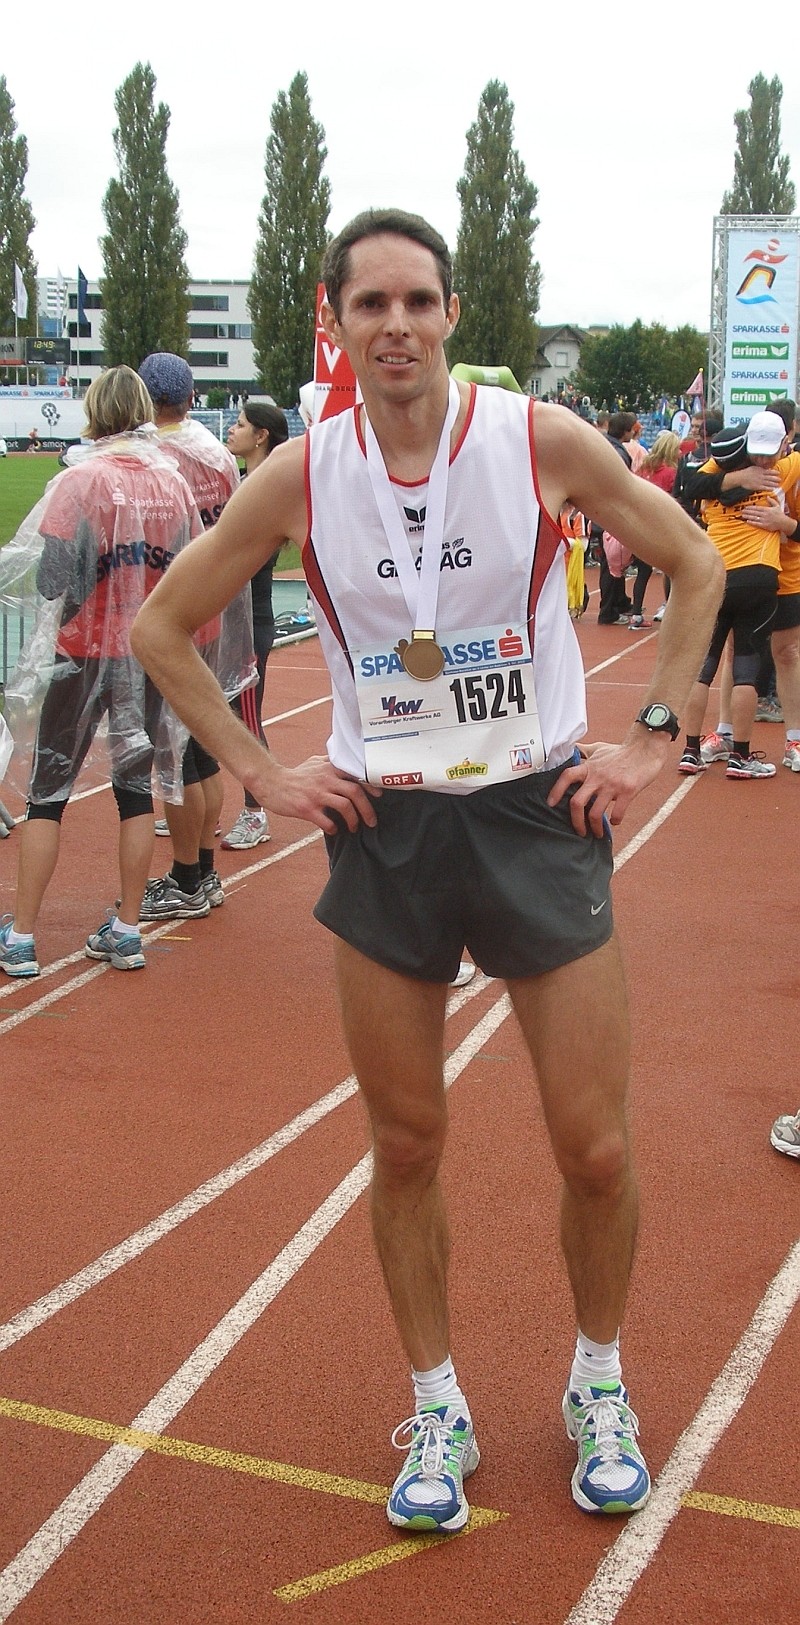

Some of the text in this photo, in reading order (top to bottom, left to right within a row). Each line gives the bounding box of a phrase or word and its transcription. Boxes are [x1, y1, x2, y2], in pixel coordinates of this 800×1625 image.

[732, 325, 780, 333] SPARKASSE
[733, 345, 768, 356] erima
[731, 371, 779, 379] SPARKASSE
[732, 391, 766, 402] erima
[129, 496, 174, 507] Sparkasse
[130, 509, 174, 520] Bdensee
[360, 639, 497, 677] SPAASSE
[449, 669, 526, 723] 1524
[369, 717, 402, 727] Vorarlberger
[403, 713, 432, 723] Kraftwerke
[448, 767, 486, 779] pfanner
[384, 774, 421, 785] ORF V
